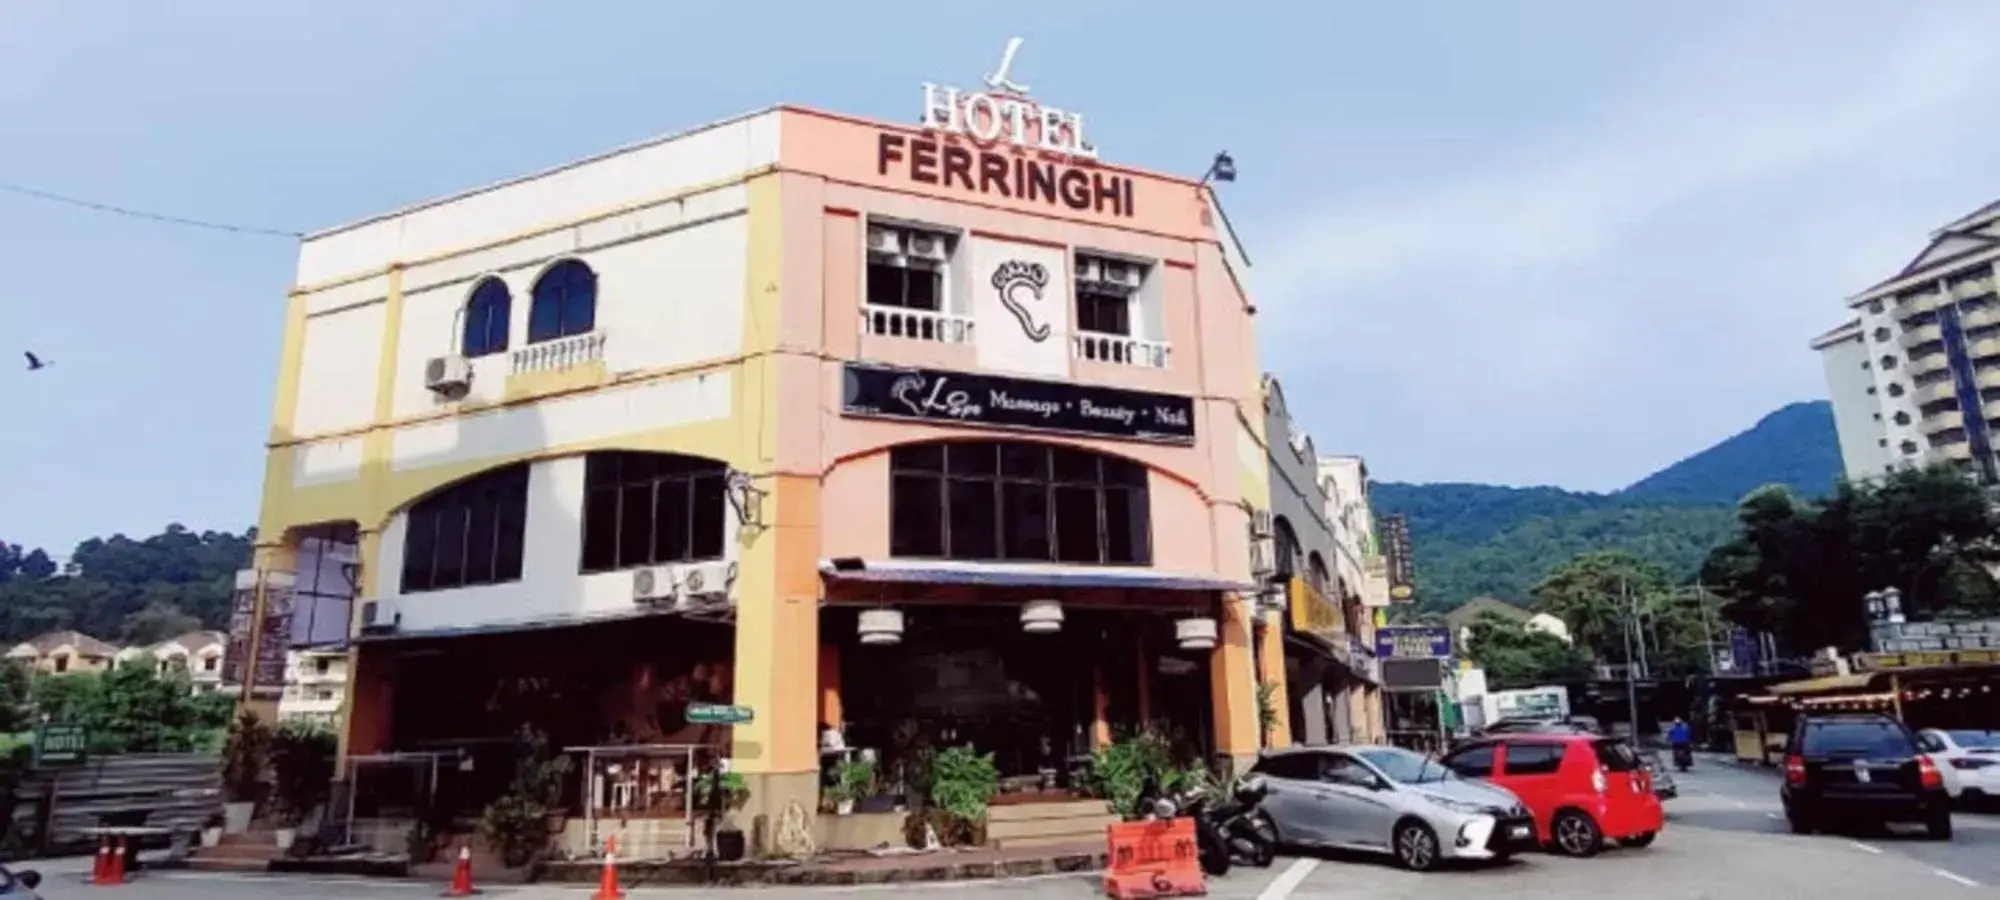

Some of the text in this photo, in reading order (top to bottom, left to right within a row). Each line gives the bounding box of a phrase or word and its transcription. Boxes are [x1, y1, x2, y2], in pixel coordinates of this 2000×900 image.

[983, 36, 1030, 93] L
[921, 81, 1098, 157] HOTEL
[878, 132, 1134, 217] FERRINGHI
[989, 389, 1060, 419] Massage
[1079, 398, 1136, 426] Beauty
